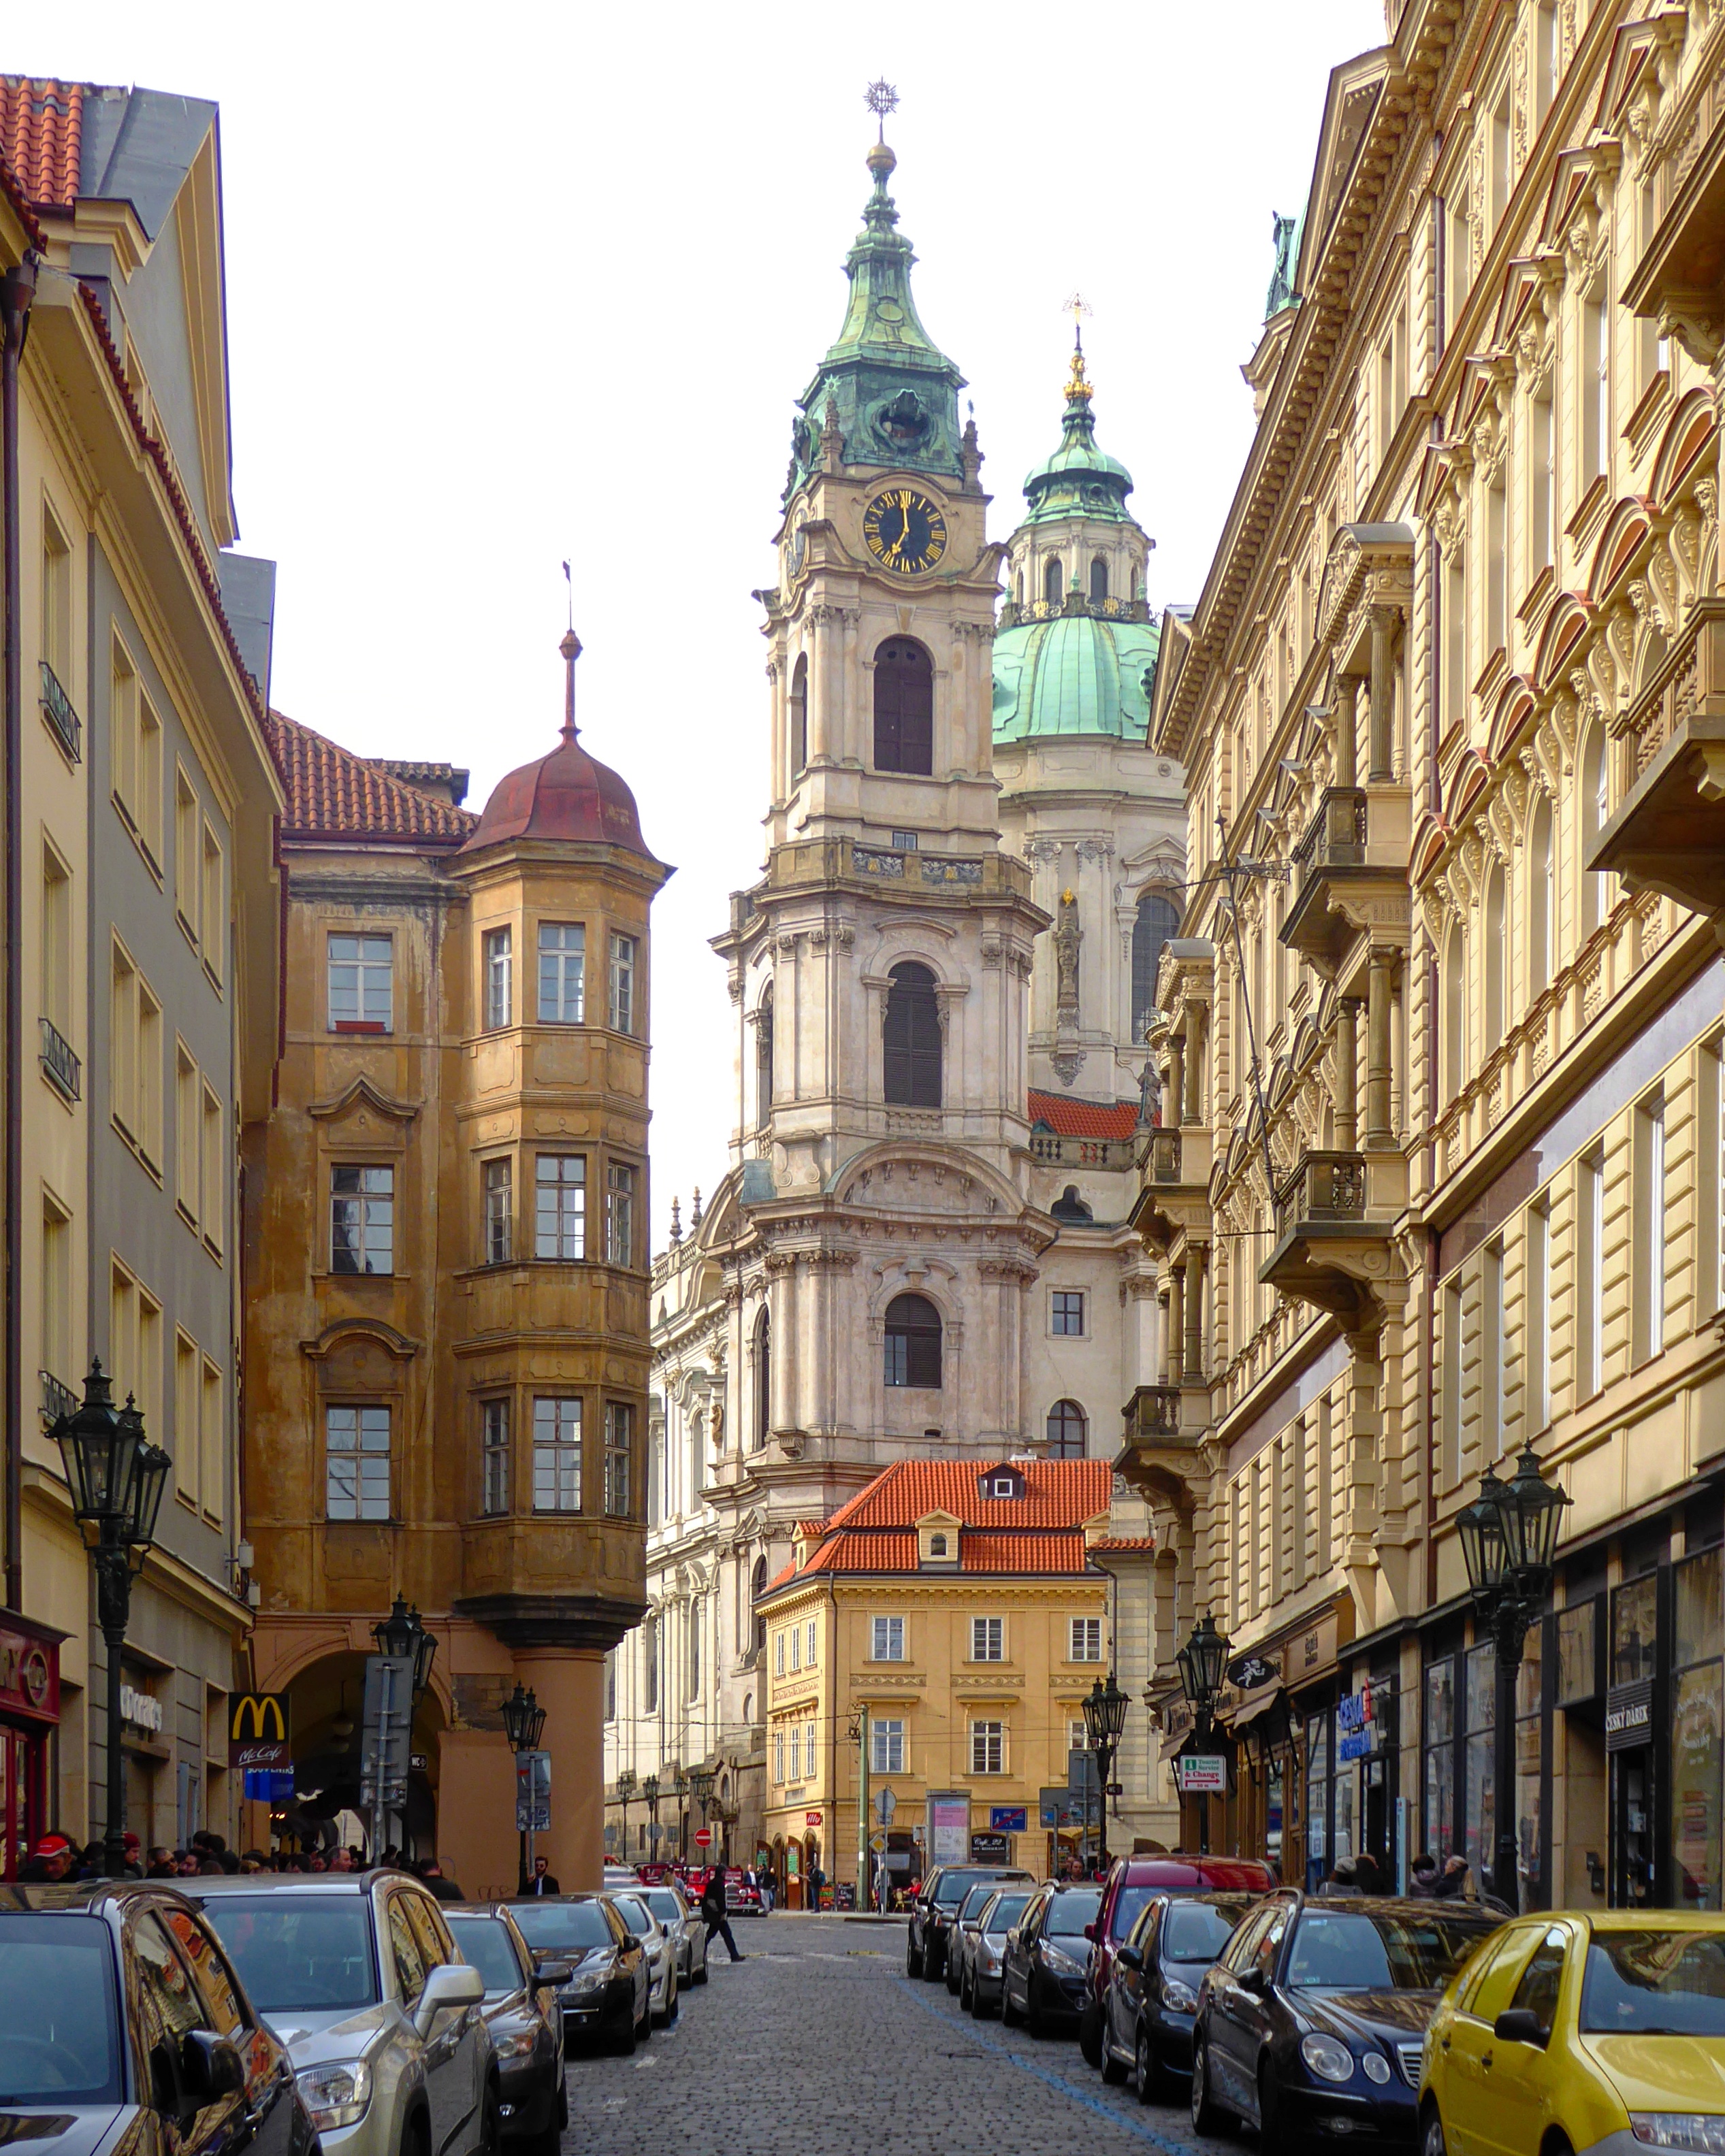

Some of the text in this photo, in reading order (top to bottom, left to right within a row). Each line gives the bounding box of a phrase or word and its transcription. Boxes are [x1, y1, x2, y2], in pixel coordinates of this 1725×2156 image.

[869, 504, 884, 518] X
[931, 530, 946, 541] III
[1626, 1703, 1649, 1727] DÁREK
[411, 1757, 420, 1766] WC
[807, 1813, 820, 1825] illy
